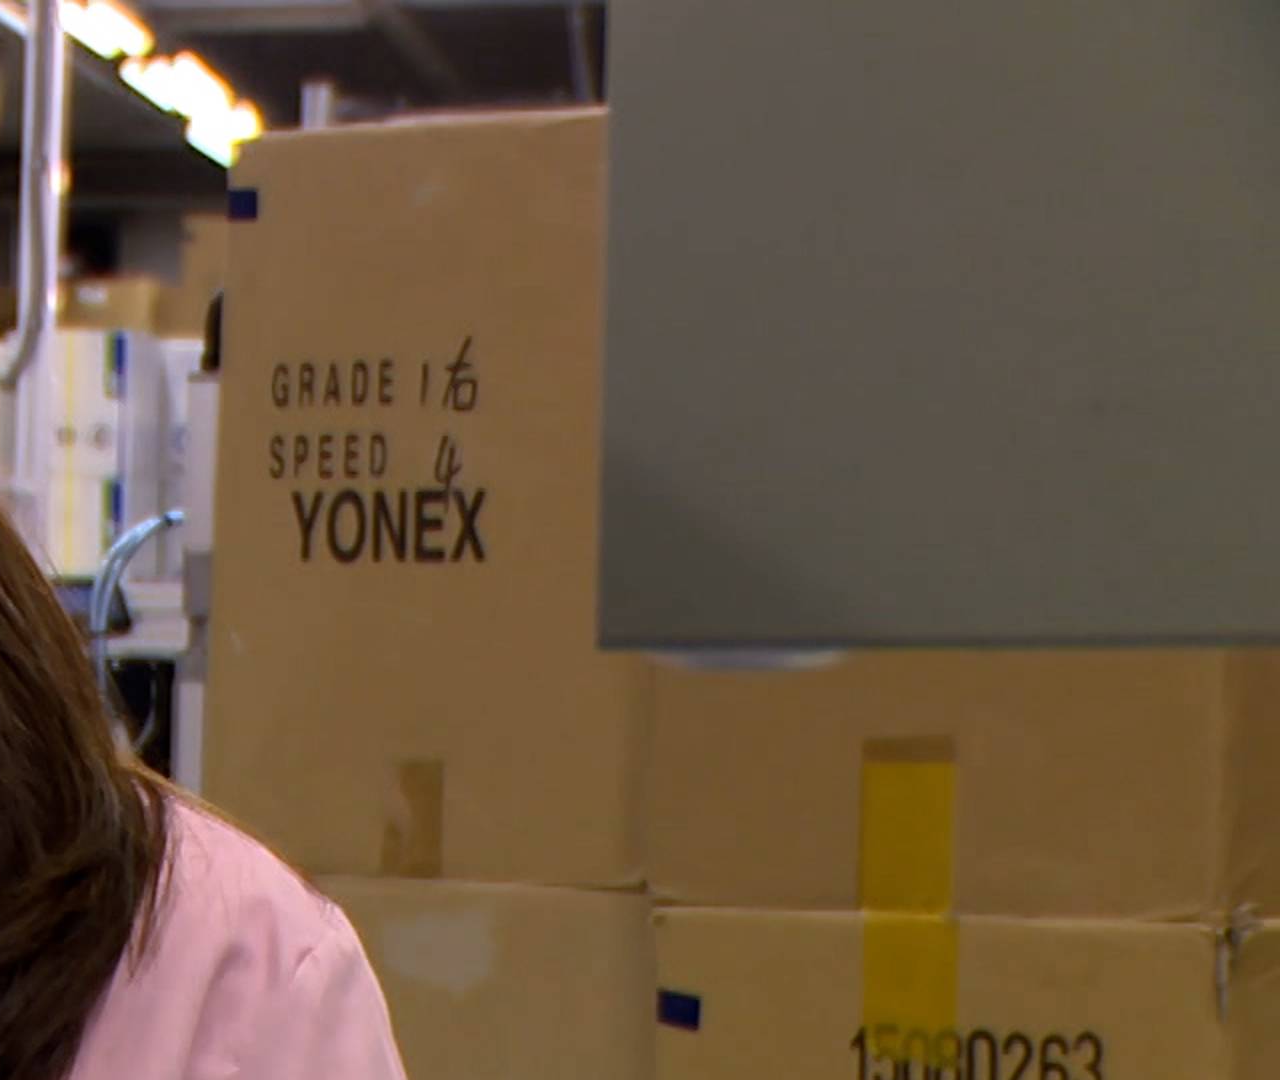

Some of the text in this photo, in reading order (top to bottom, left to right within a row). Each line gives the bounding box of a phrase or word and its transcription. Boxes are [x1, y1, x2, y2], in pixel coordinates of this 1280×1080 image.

[271, 360, 394, 408] GRADE
[269, 433, 388, 480] SPEED
[291, 487, 487, 563] YONEX
